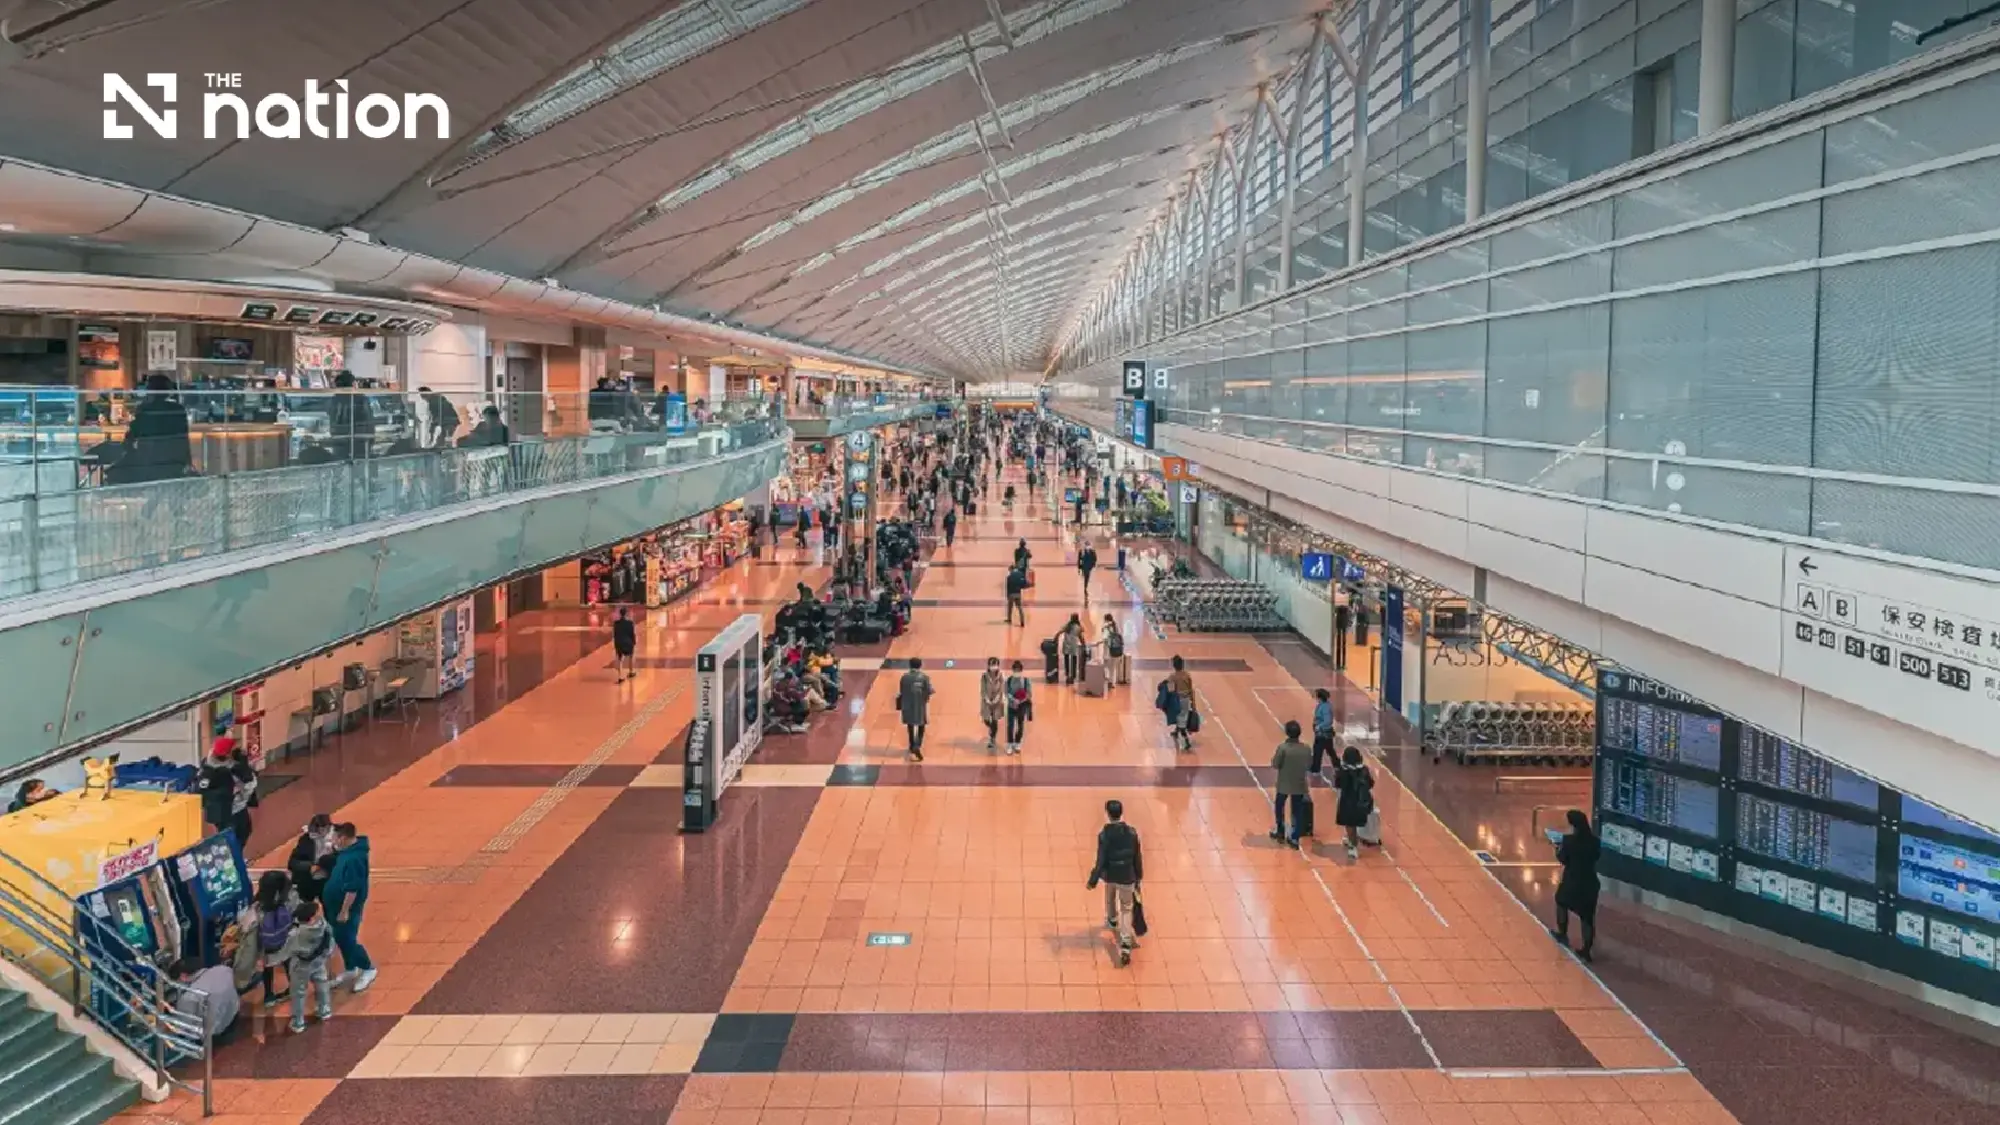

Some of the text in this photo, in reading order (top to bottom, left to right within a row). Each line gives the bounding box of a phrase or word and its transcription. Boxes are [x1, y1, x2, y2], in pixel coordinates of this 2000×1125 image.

[240, 302, 378, 327] BEER
[1127, 367, 1143, 388] B
[1802, 591, 1848, 617] A B
